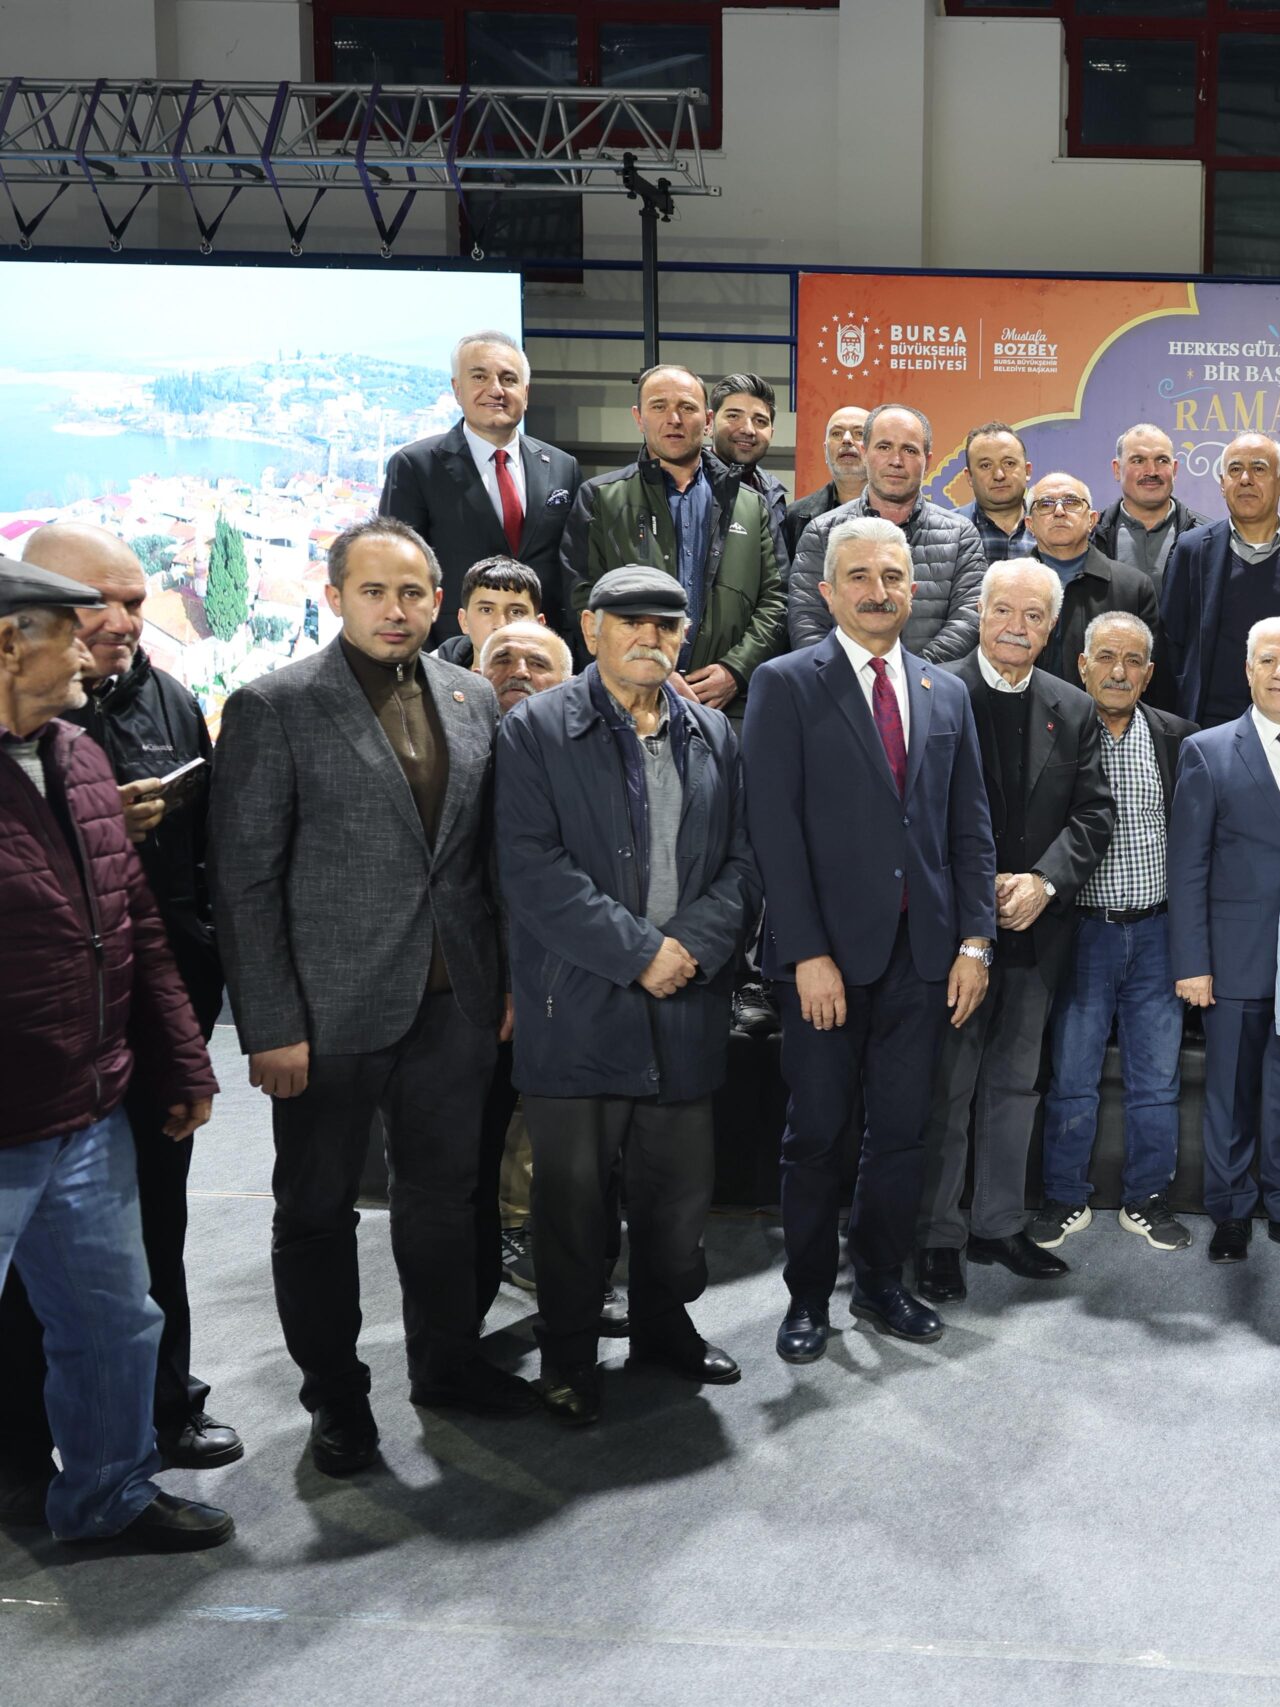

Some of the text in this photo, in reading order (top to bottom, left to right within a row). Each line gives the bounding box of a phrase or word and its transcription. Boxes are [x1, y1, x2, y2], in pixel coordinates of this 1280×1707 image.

[890, 324, 967, 342] BURSA
[1001, 327, 1047, 345] Mustafa
[890, 343, 967, 358] BÜYÜKŞEHİR
[994, 343, 1058, 356] BOZBEY
[1168, 341, 1239, 357] HERKES
[890, 357, 967, 371] BELEDİYESİ
[1027, 366, 1058, 374] BAŞKANI
[1203, 361, 1241, 382] BİR
